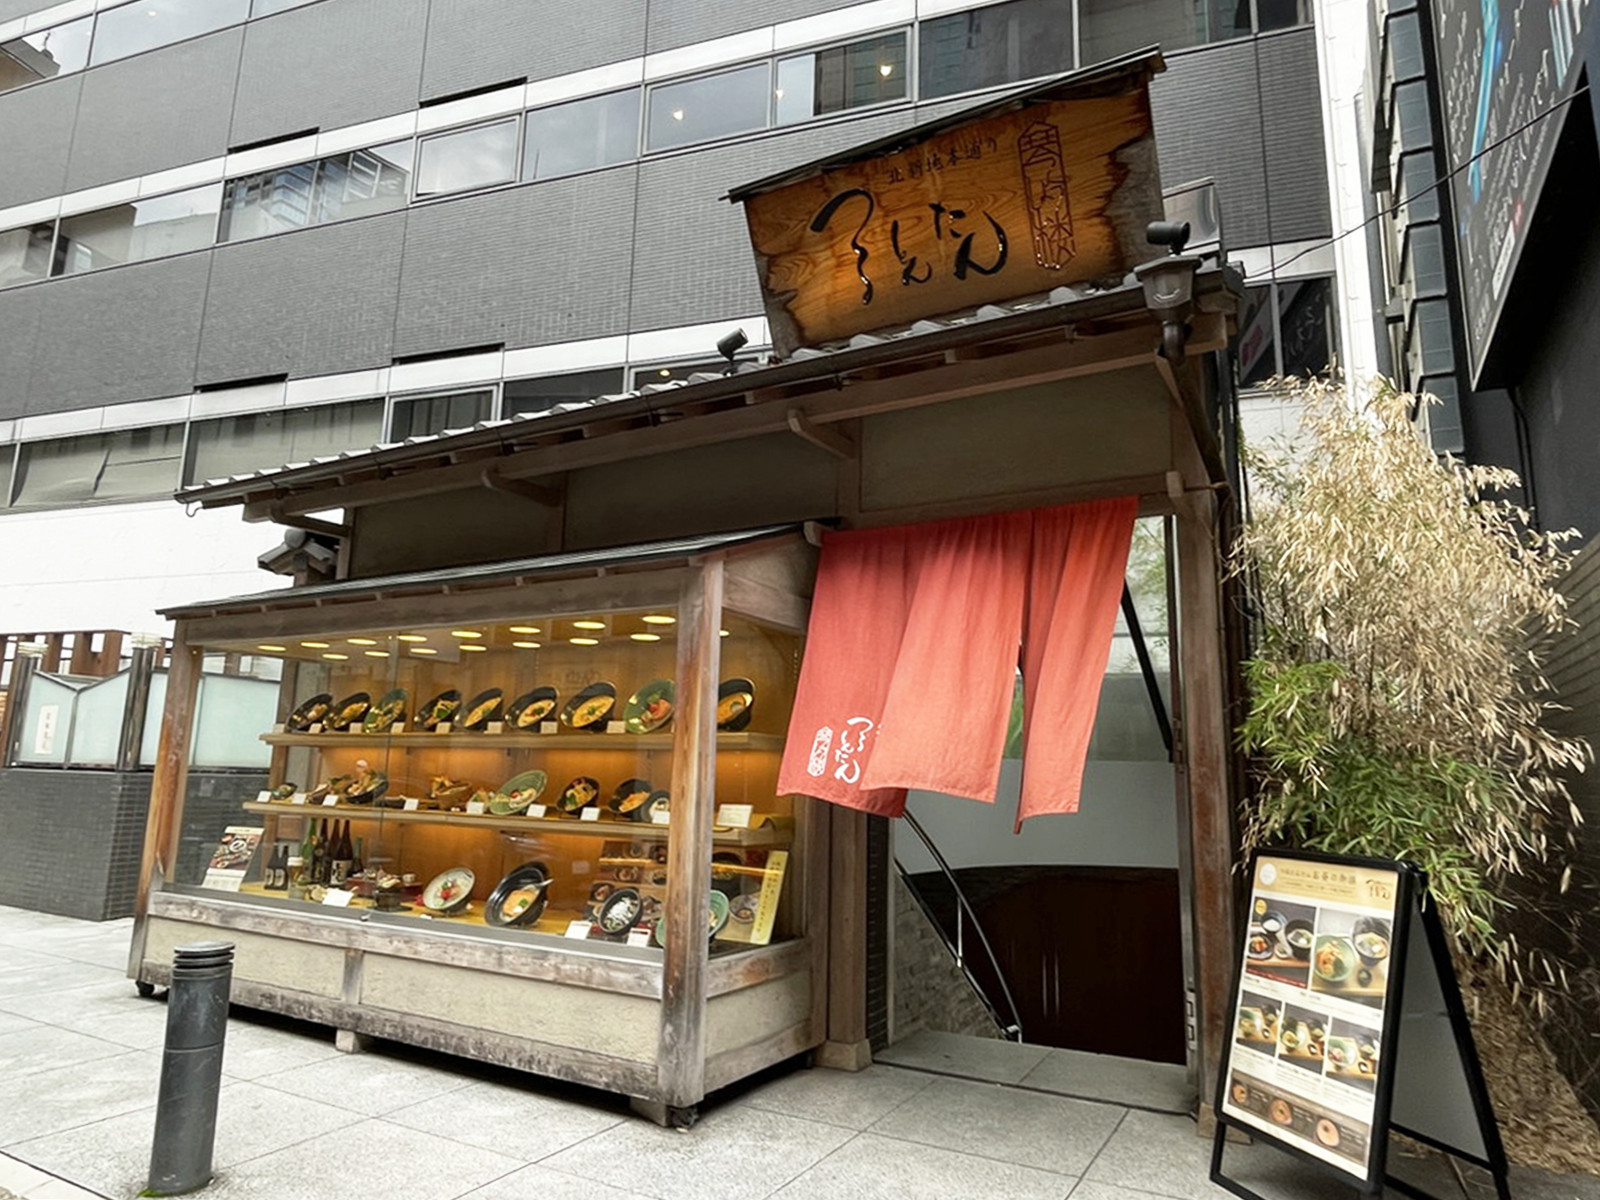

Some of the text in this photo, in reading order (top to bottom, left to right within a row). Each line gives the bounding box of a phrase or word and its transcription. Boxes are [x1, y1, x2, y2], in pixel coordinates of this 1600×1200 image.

[887, 137, 998, 185] 北新地本通り
[809, 188, 1009, 305] つるとんたん
